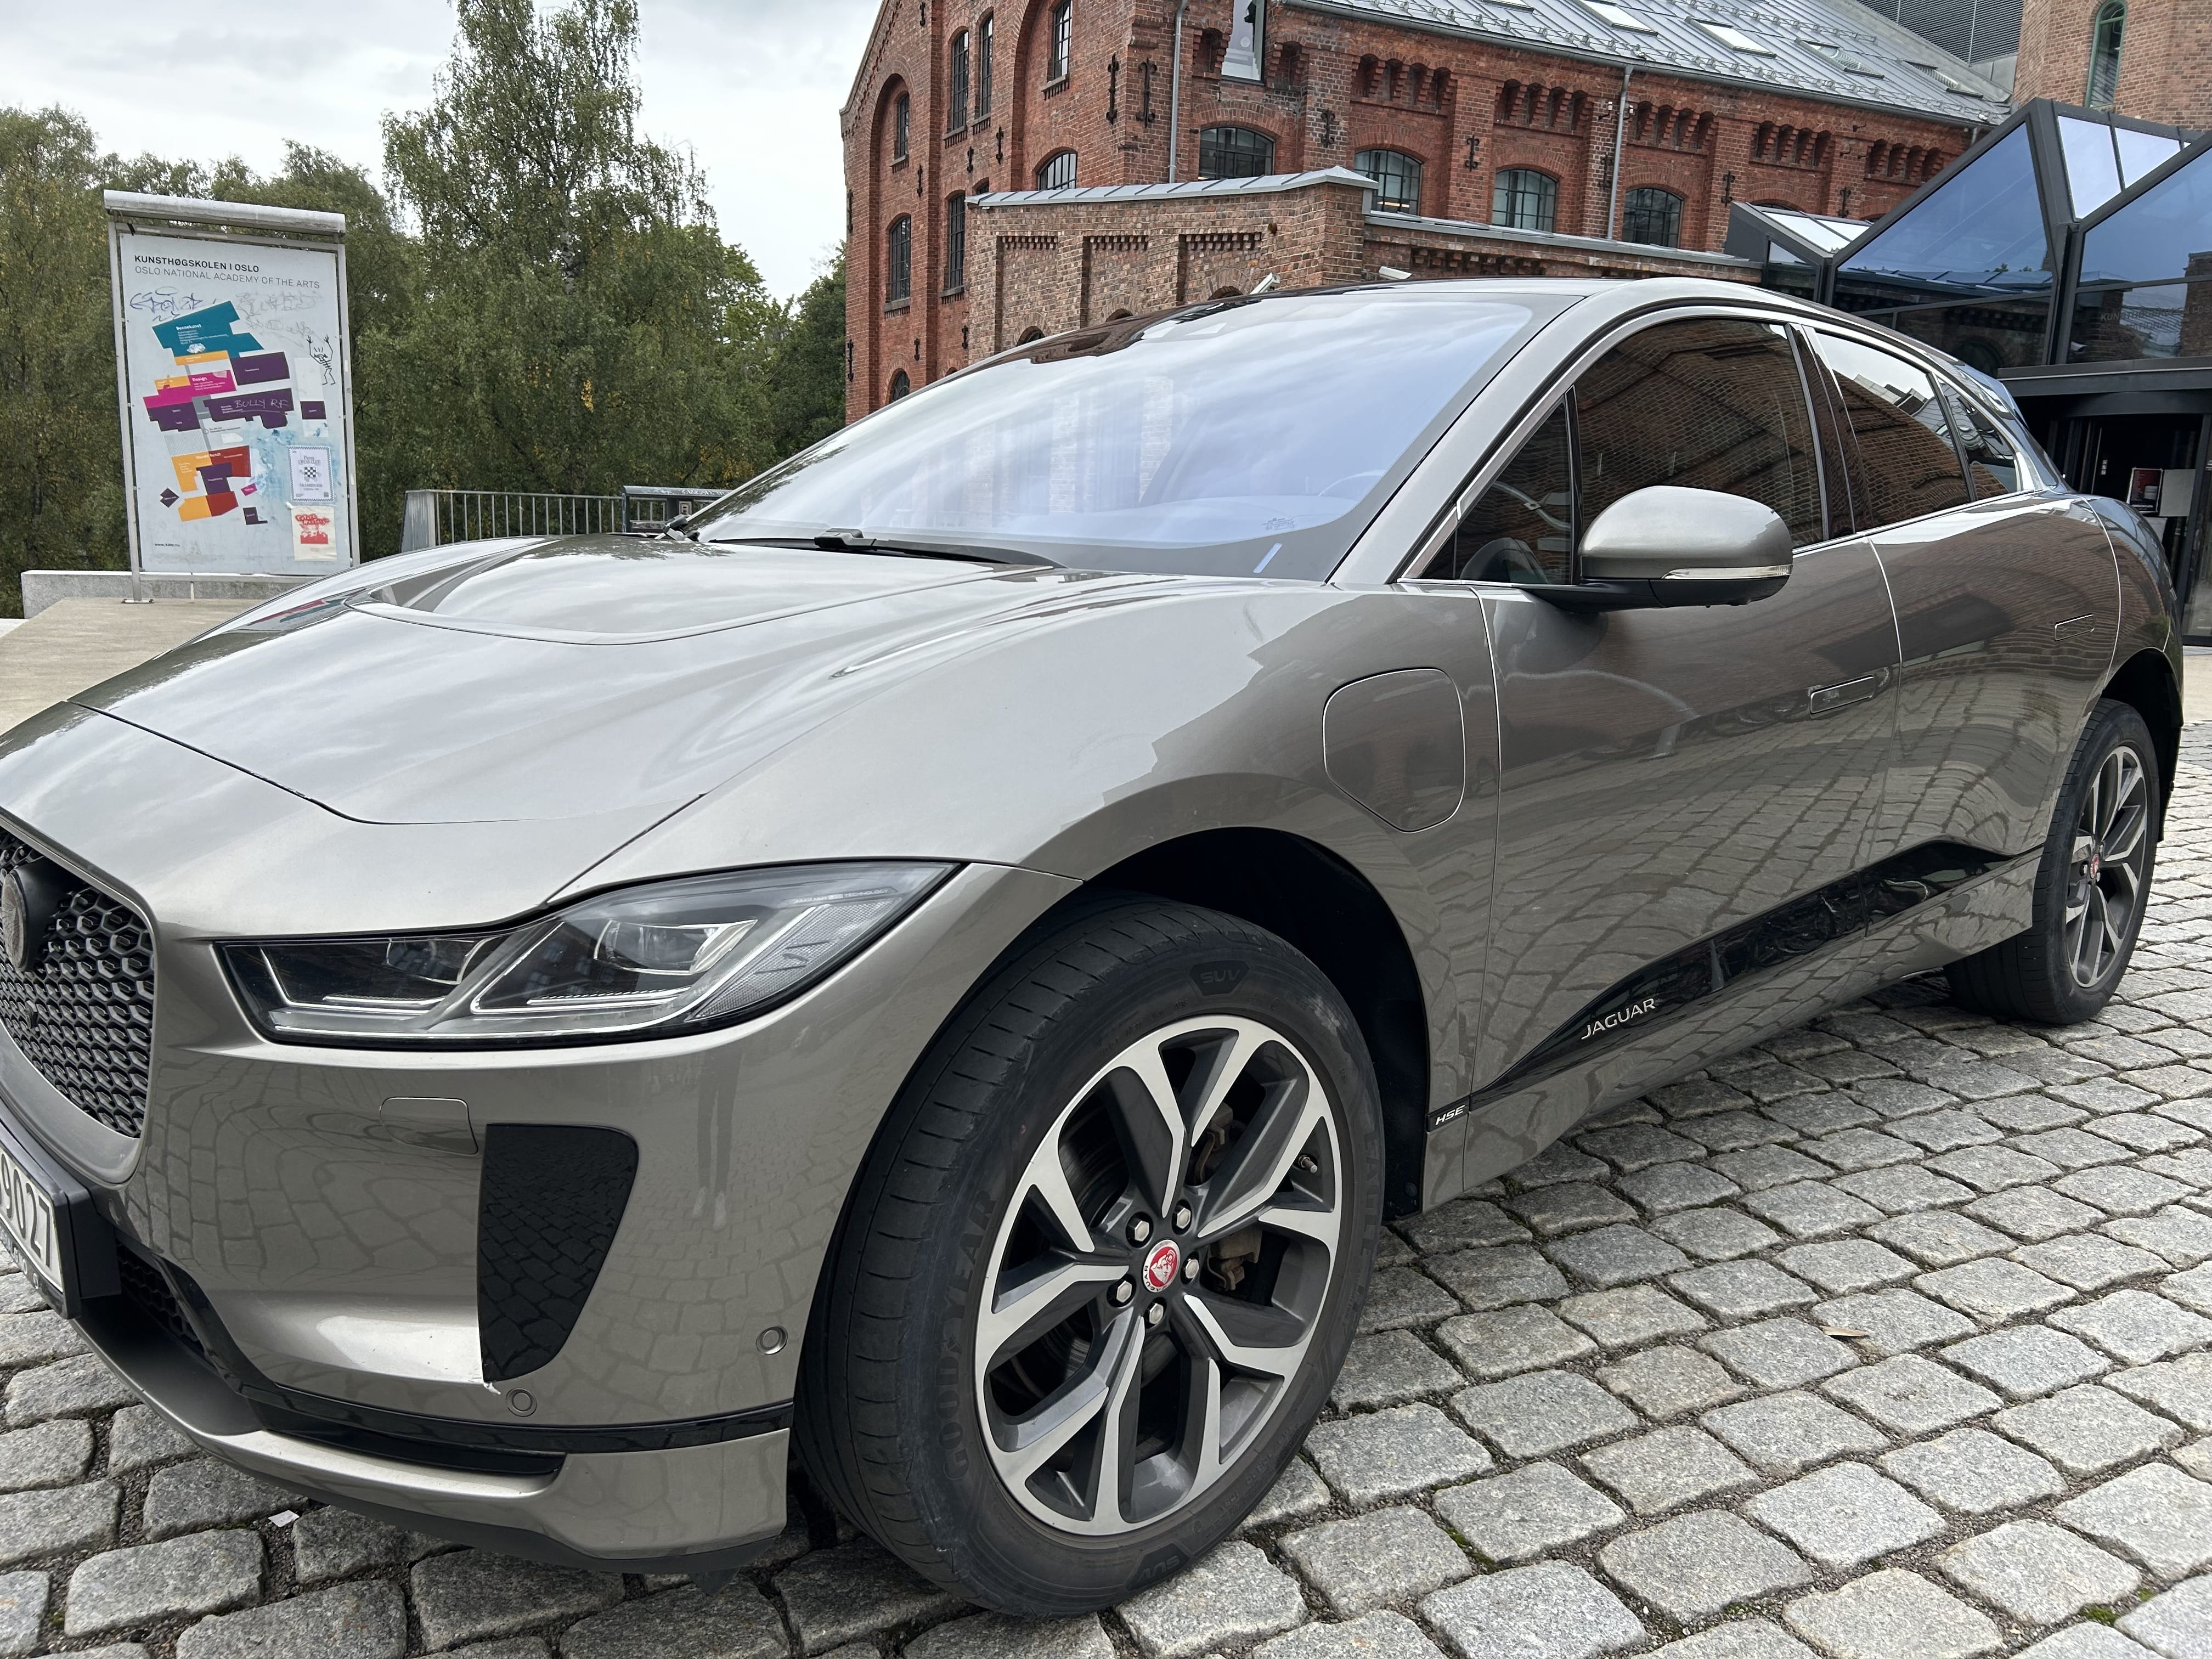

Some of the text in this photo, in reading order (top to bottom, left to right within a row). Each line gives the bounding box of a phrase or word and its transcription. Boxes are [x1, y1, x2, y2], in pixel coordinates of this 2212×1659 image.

[135, 255, 227, 270] KUNSTHØGSKOLEN
[235, 264, 259, 273] OSLO
[136, 266, 161, 275] OSLO
[163, 268, 211, 279] NATIONAL
[214, 273, 259, 283] ACADEMY
[276, 278, 294, 286] THE
[297, 280, 320, 289] ARTS
[844, 888, 888, 897] TECHNOLOGY
[1200, 969, 1240, 984] SUV
[1581, 997, 1656, 1040] JAGUAR
[1435, 1104, 1465, 1126] HSE
[0, 1154, 51, 1268] 9027
[935, 1189, 997, 1480] GOODYEAR
[1136, 1555, 1180, 1583] SUV
